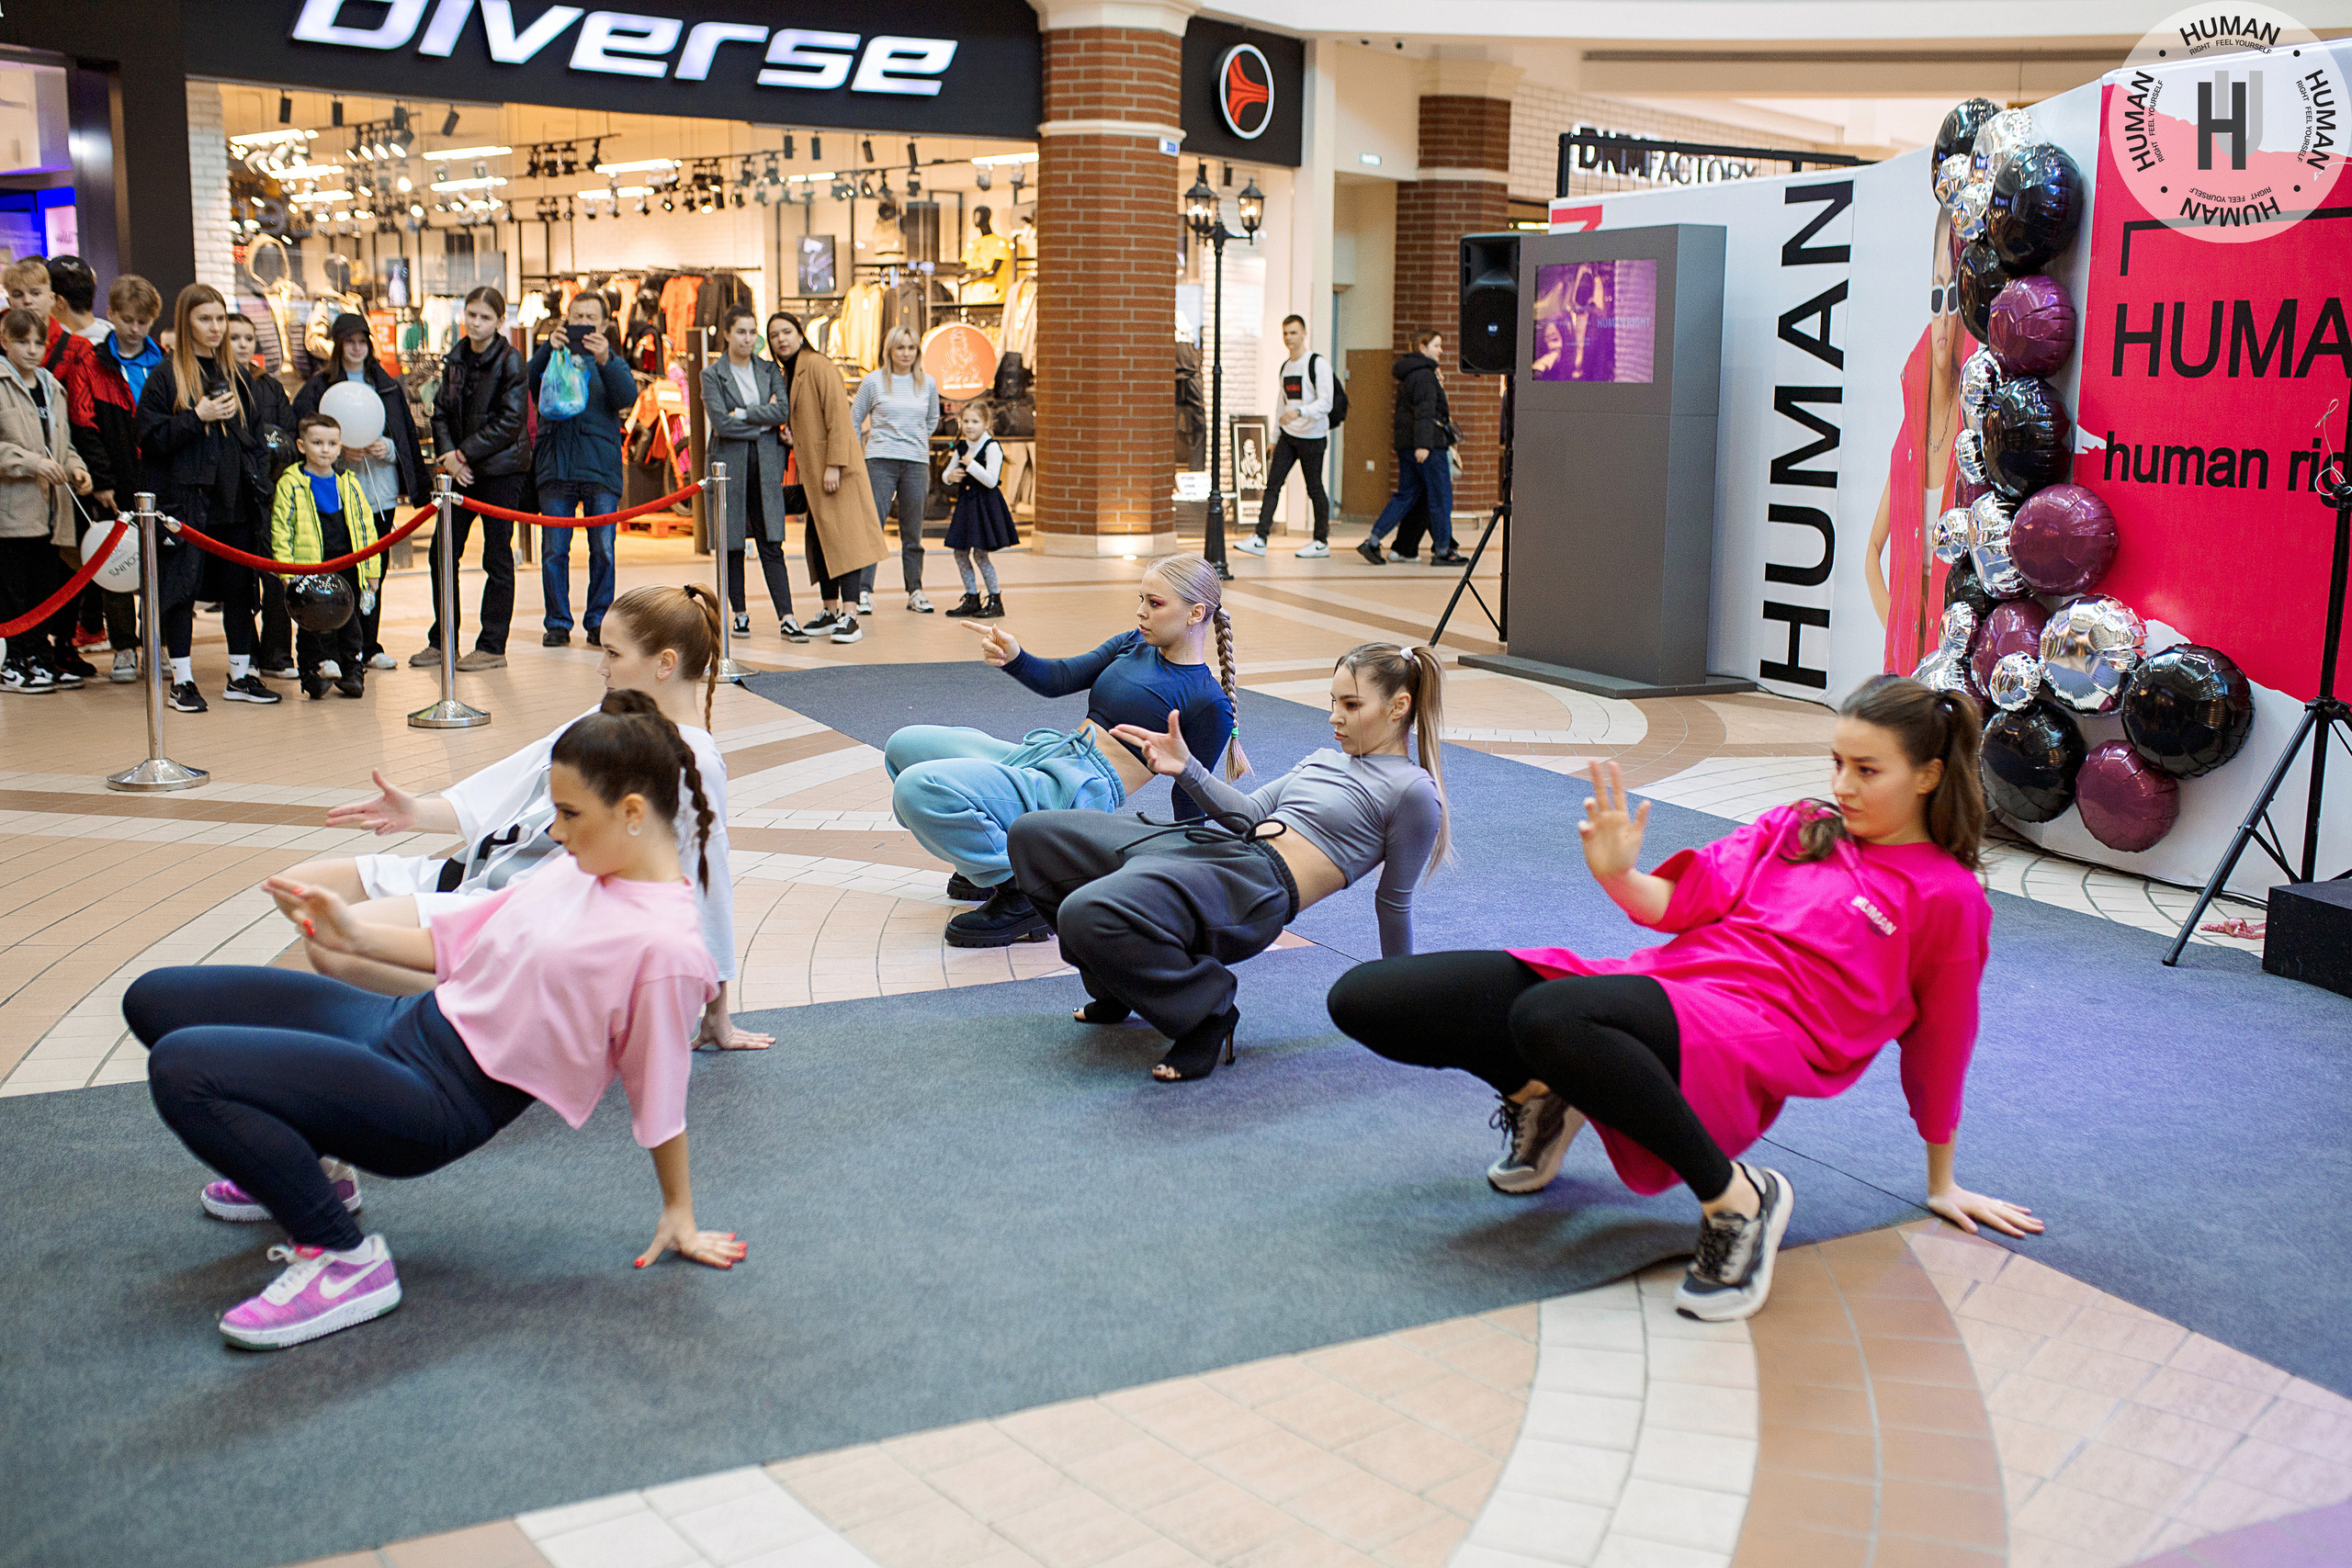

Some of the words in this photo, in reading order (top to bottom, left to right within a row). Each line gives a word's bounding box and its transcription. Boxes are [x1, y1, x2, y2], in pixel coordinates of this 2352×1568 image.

[1597, 318, 1626, 329] HUMAN
[1759, 180, 1854, 689] HUMAN
[2104, 431, 2269, 491] human
